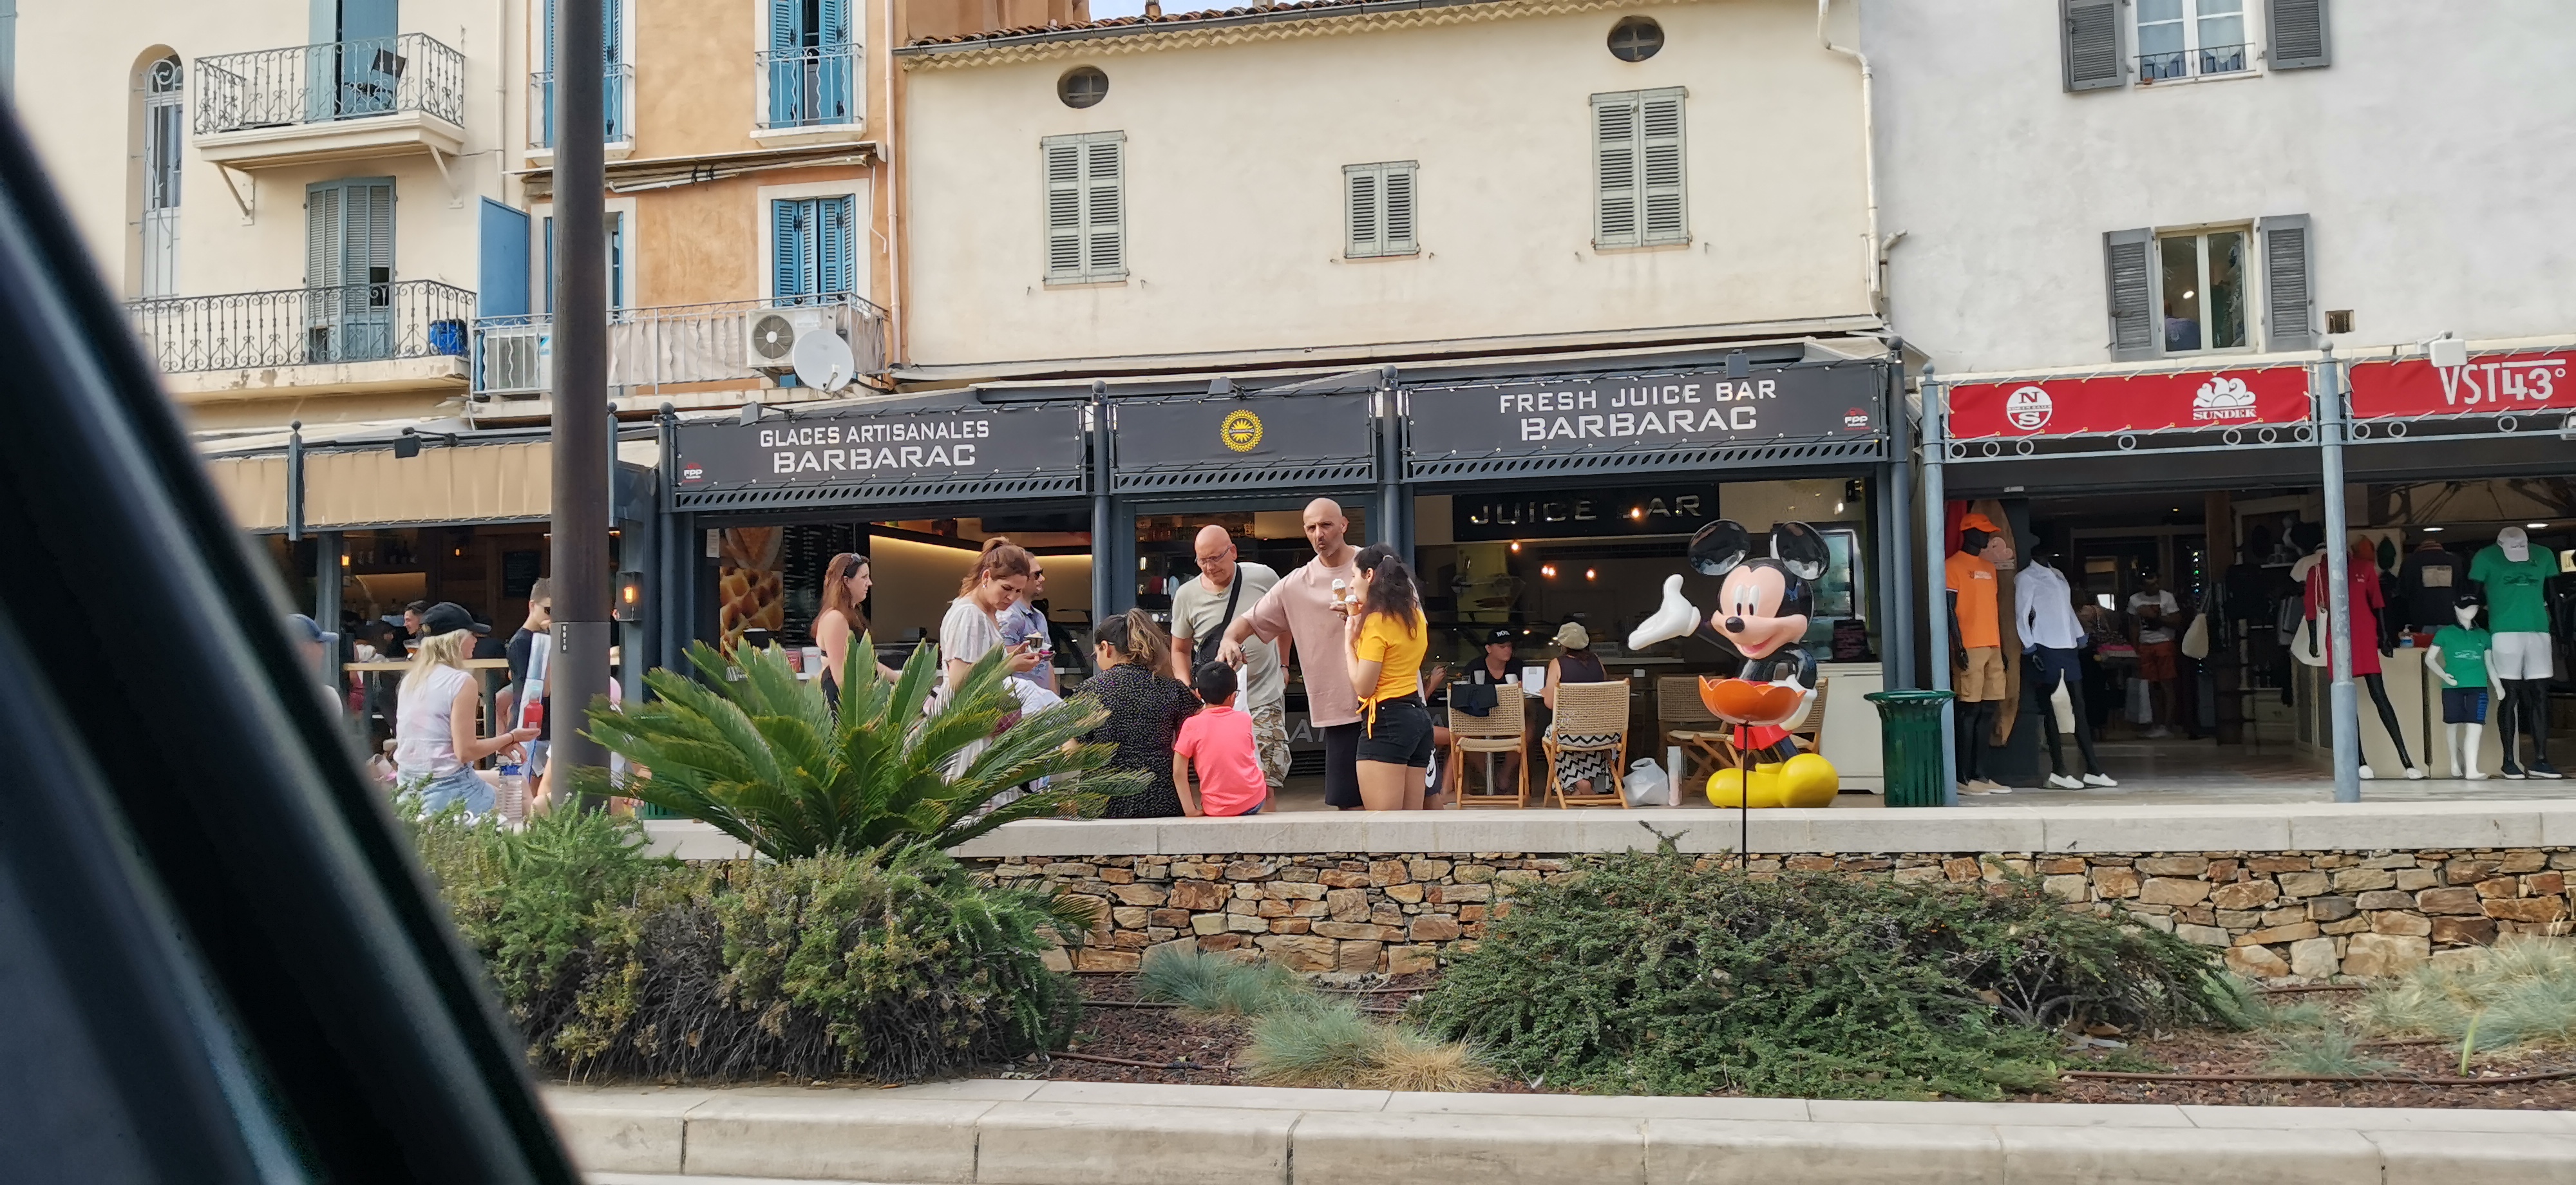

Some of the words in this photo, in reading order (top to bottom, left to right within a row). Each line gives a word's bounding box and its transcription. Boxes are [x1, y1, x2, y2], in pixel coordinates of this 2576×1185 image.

[1500, 390, 1597, 413] FRESH
[1611, 384, 1701, 408] JUICE
[1716, 379, 1777, 402] BAR
[2018, 391, 2041, 404] N
[1520, 406, 1757, 441] BARBARAC
[1844, 415, 1868, 424] FPP
[2018, 412, 2041, 426] S
[2192, 408, 2257, 421] SUNDEK
[760, 426, 840, 448] GLACES
[846, 420, 989, 444] ARTISANALES
[773, 444, 976, 473] BARBARAC
[1471, 500, 1598, 525] JUICE
